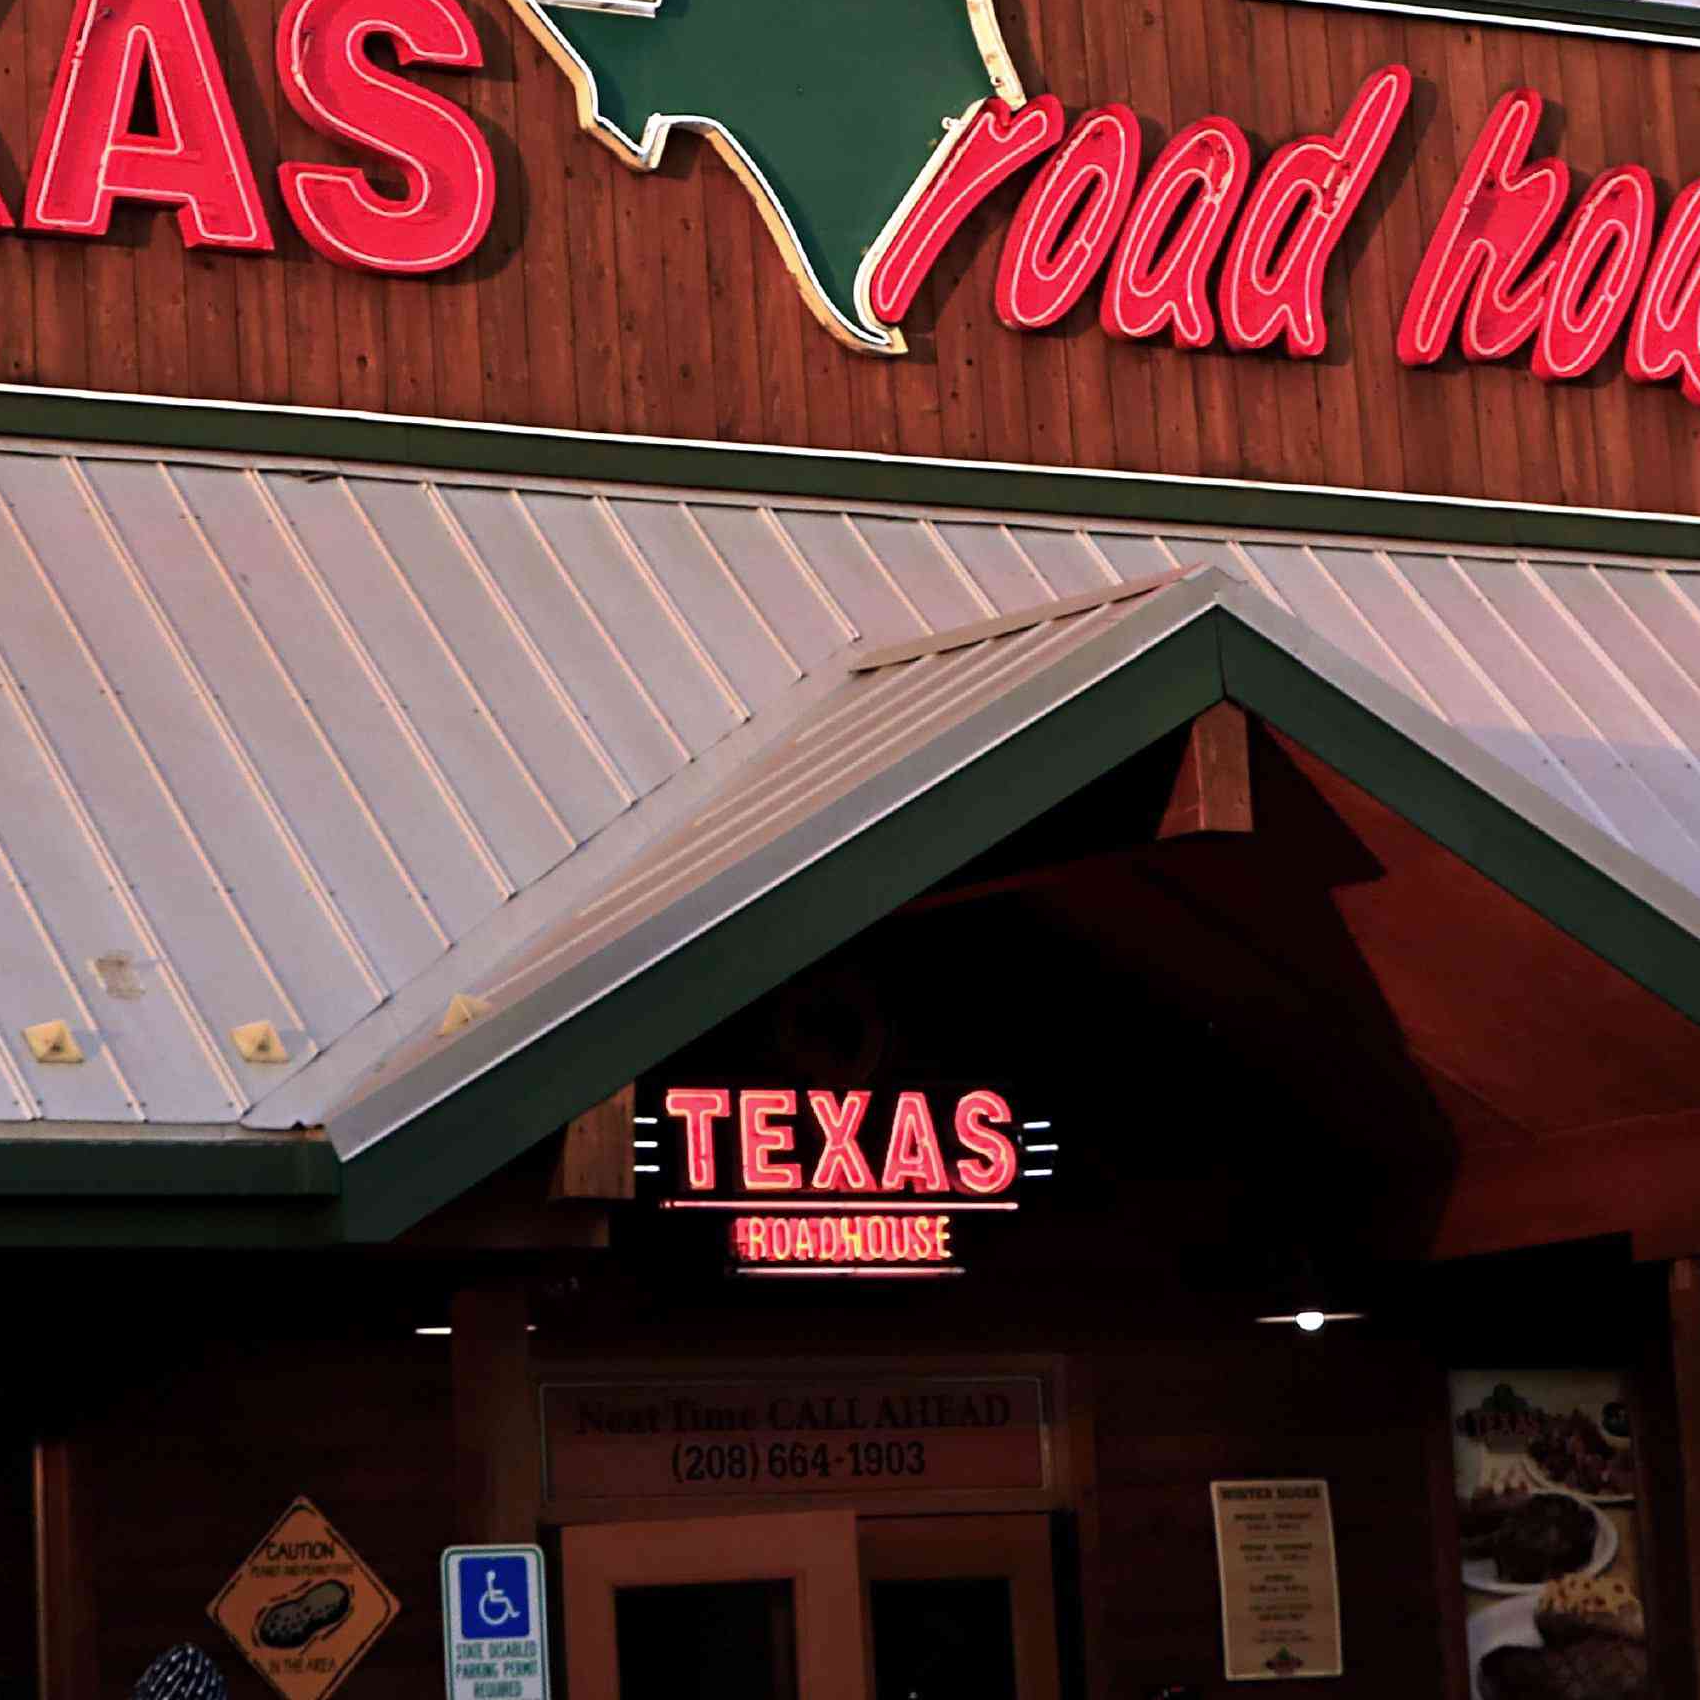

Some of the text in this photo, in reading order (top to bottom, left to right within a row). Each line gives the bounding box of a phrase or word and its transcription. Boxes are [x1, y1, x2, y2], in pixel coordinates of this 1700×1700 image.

[870, 64, 1410, 358] road
[666, 1087, 1018, 1194] TEXAS
[736, 1215, 953, 1261] ROADHOUSE
[767, 1396, 866, 1430] CALL
[874, 1393, 1011, 1429] AHEAD
[670, 1440, 927, 1483] (208) 664-1903
[266, 1541, 336, 1561] CAUTION
[455, 1659, 538, 1679] PARKING PERMIT
